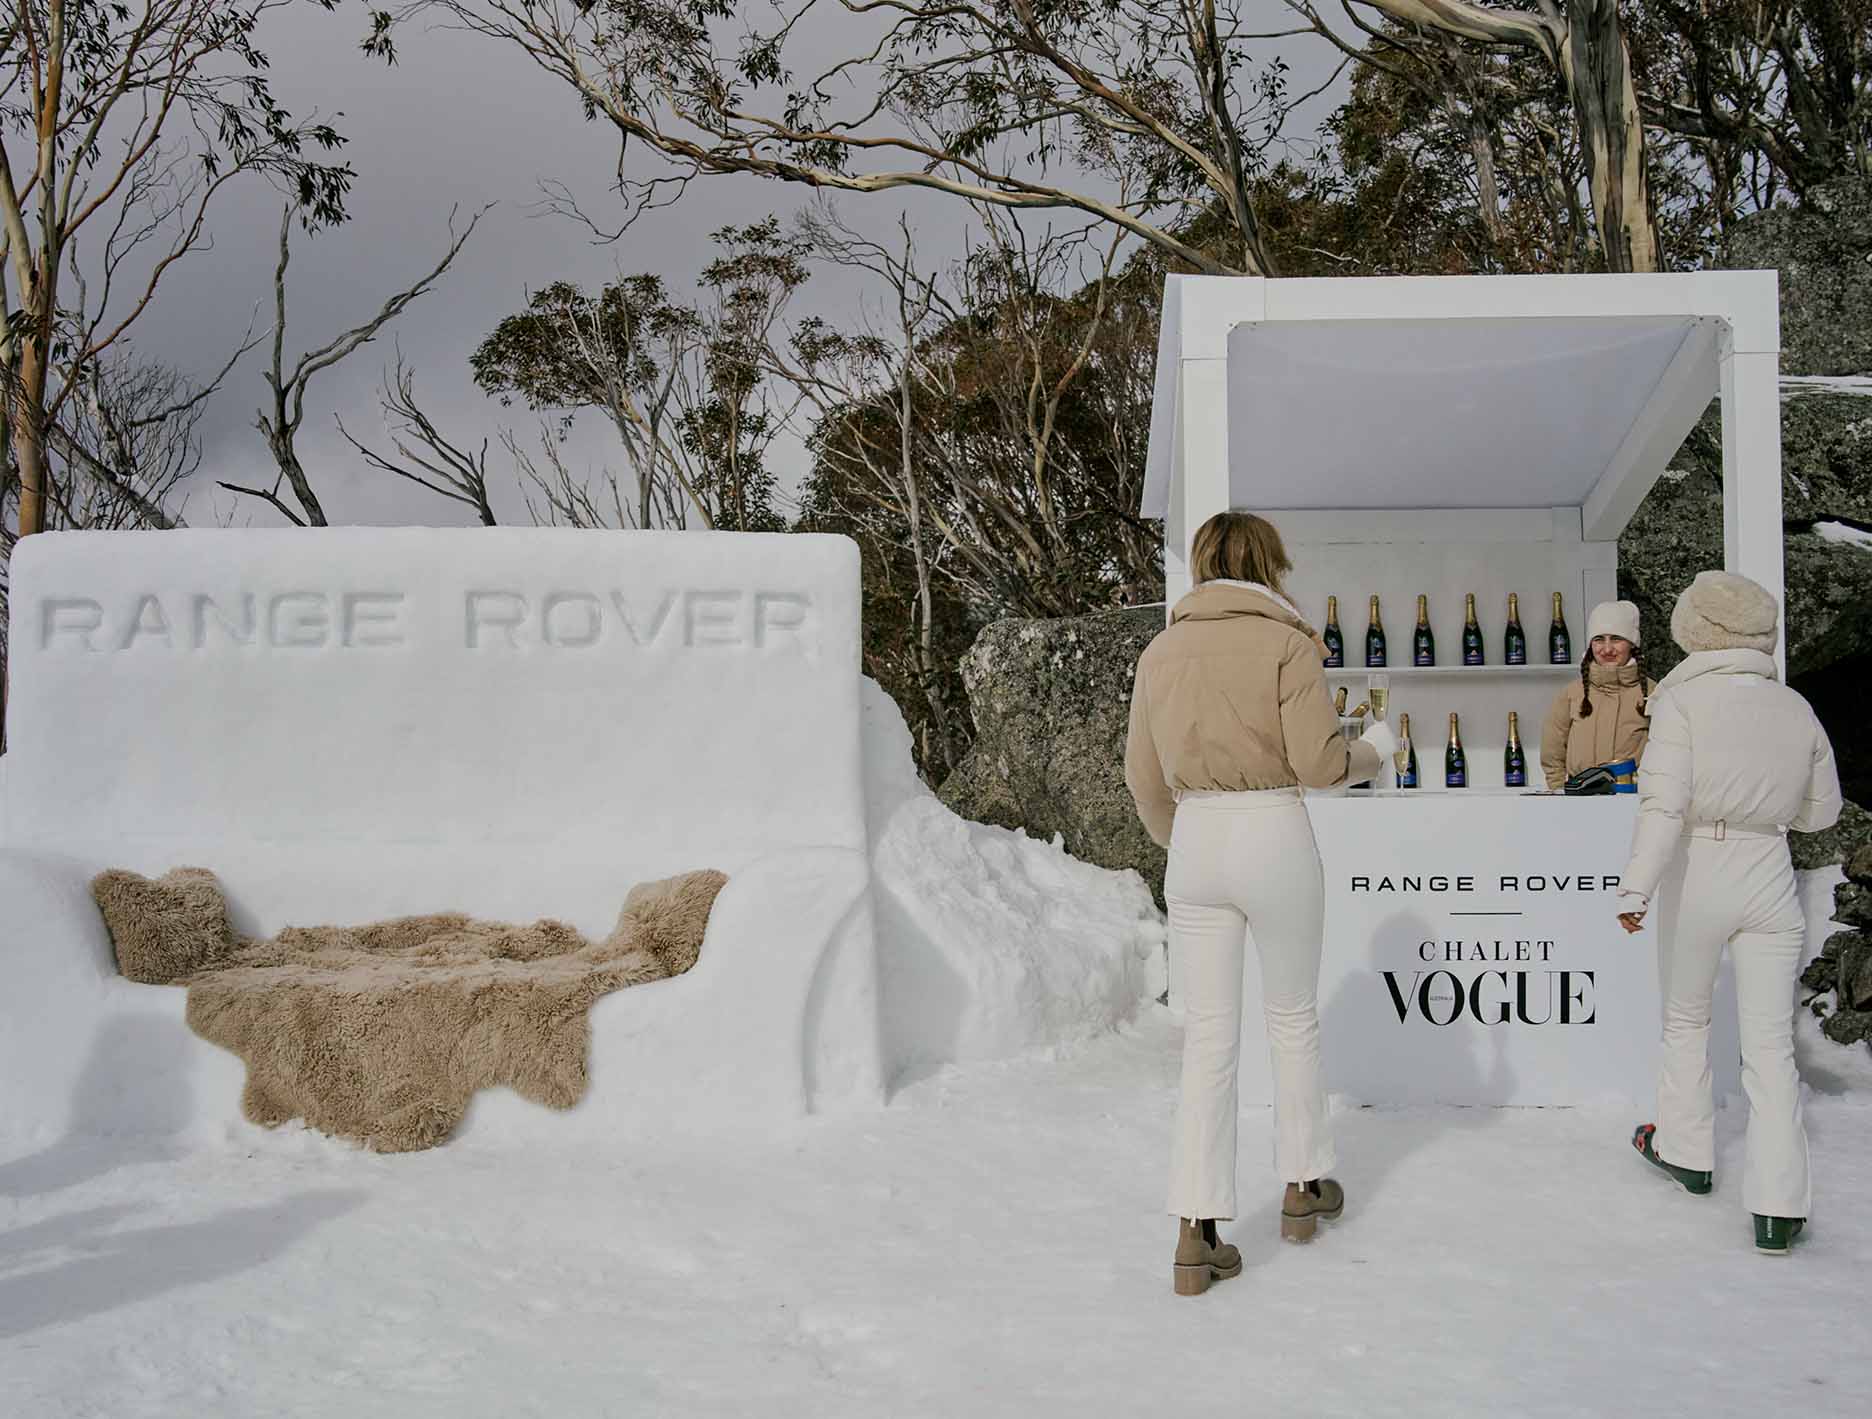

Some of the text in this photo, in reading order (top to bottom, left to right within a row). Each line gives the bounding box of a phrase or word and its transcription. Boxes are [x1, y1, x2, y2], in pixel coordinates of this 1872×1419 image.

[38, 588, 820, 653] RANGE ROVER
[1351, 876, 1621, 892] RANGE ROVER
[1418, 941, 1555, 962] CHALET
[1377, 969, 1596, 1026] VOGUE
